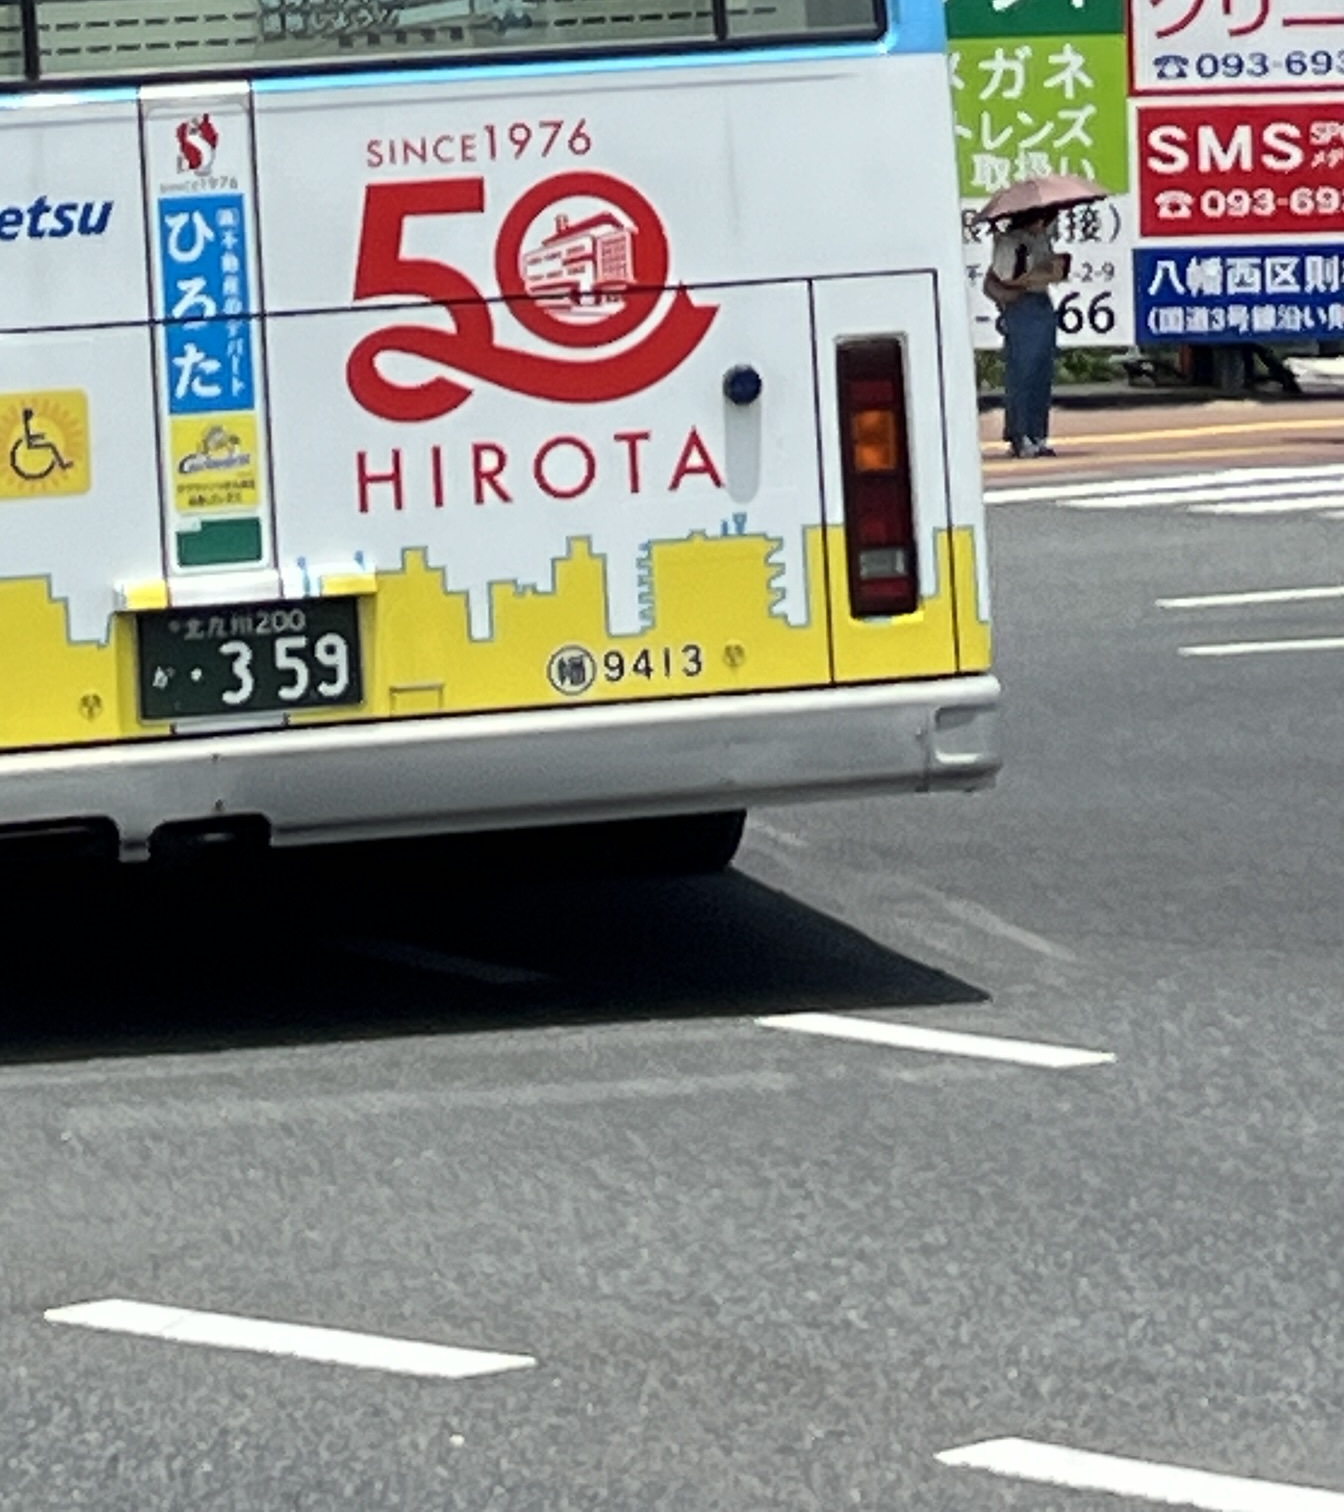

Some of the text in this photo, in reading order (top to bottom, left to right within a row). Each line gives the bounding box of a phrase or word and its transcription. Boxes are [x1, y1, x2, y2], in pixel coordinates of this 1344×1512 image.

[1147, 122, 1305, 175] SMS
[164, 210, 222, 399] ひろた
[356, 426, 724, 514] HIROTA
[604, 644, 702, 682] 9413
